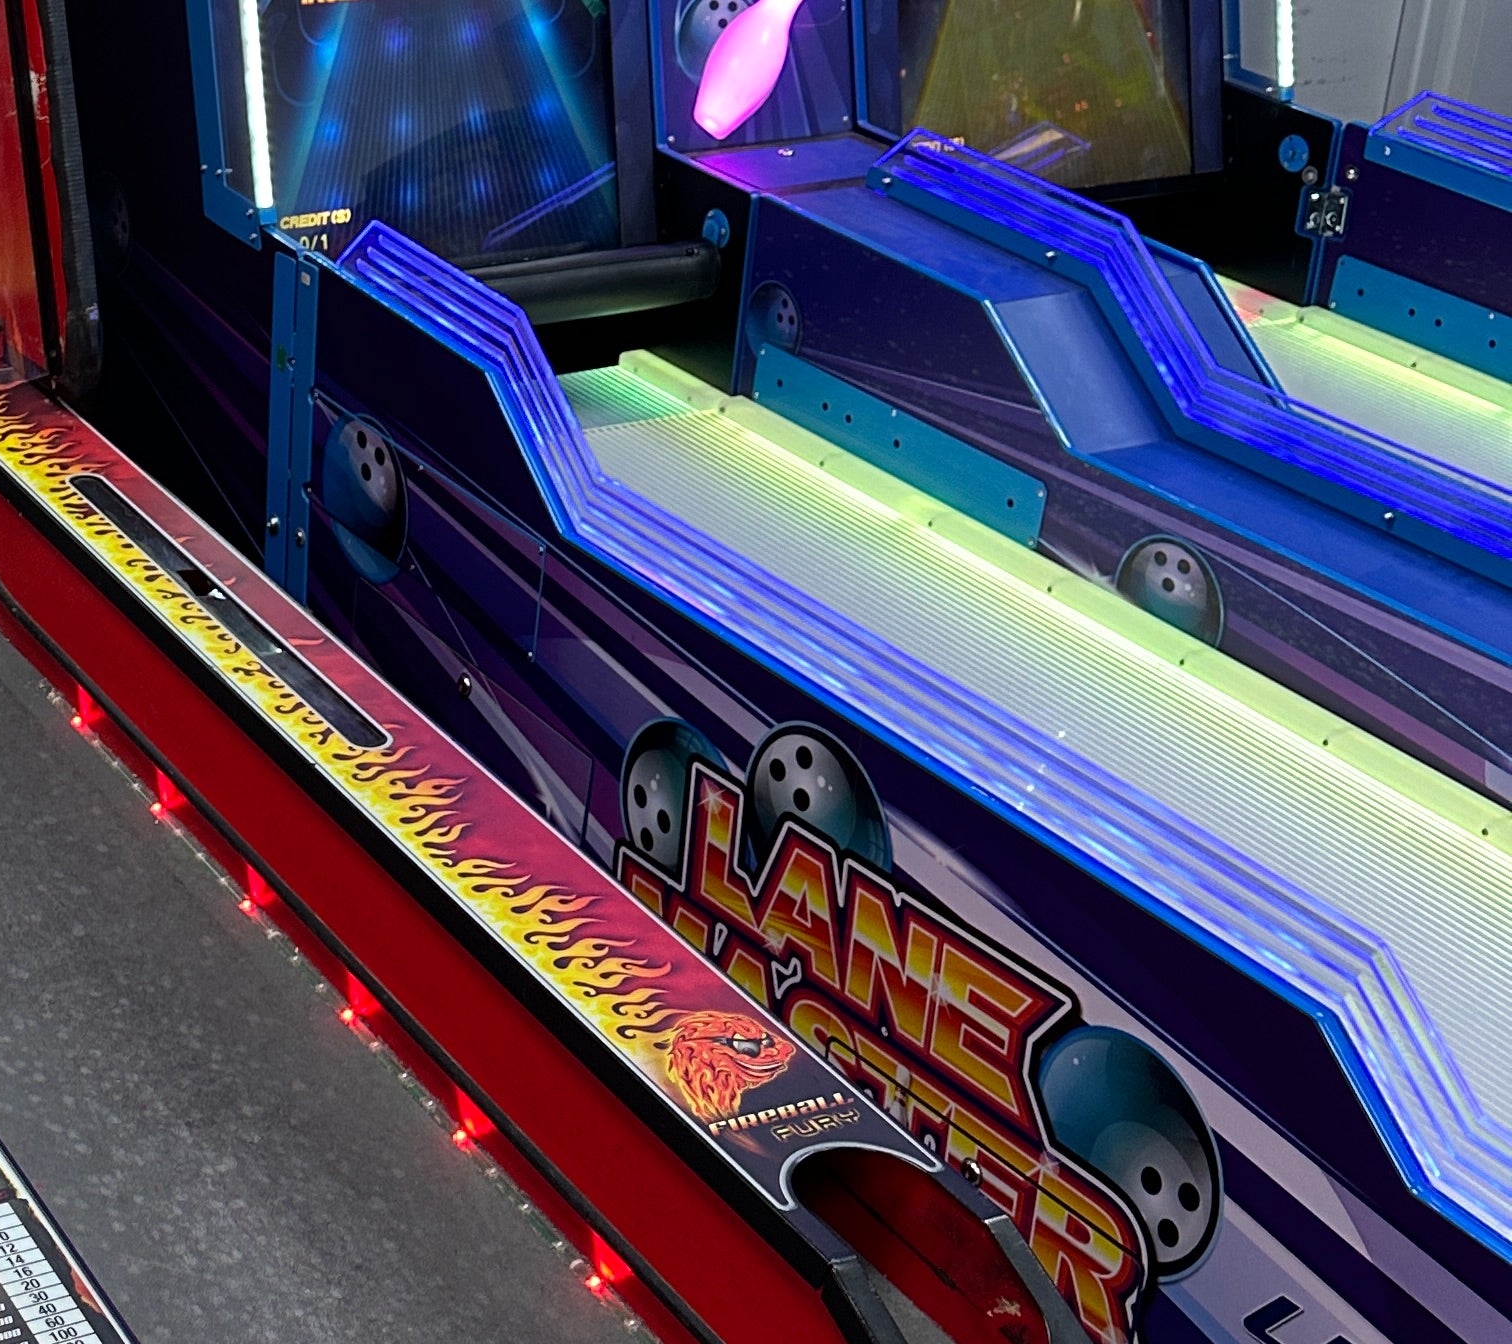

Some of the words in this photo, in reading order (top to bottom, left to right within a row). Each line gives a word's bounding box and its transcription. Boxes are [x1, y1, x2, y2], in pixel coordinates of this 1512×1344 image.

[693, 775, 1046, 1122] LANE
[708, 1092, 855, 1137] FIREBALL
[771, 1108, 861, 1143] FURY
[6, 1254, 25, 1267] 14
[13, 1266, 33, 1279] 16
[21, 1278, 41, 1291] 20
[28, 1290, 49, 1303] 30
[38, 1303, 57, 1315] 40
[45, 1315, 65, 1328] 60
[49, 1326, 78, 1343] 100
